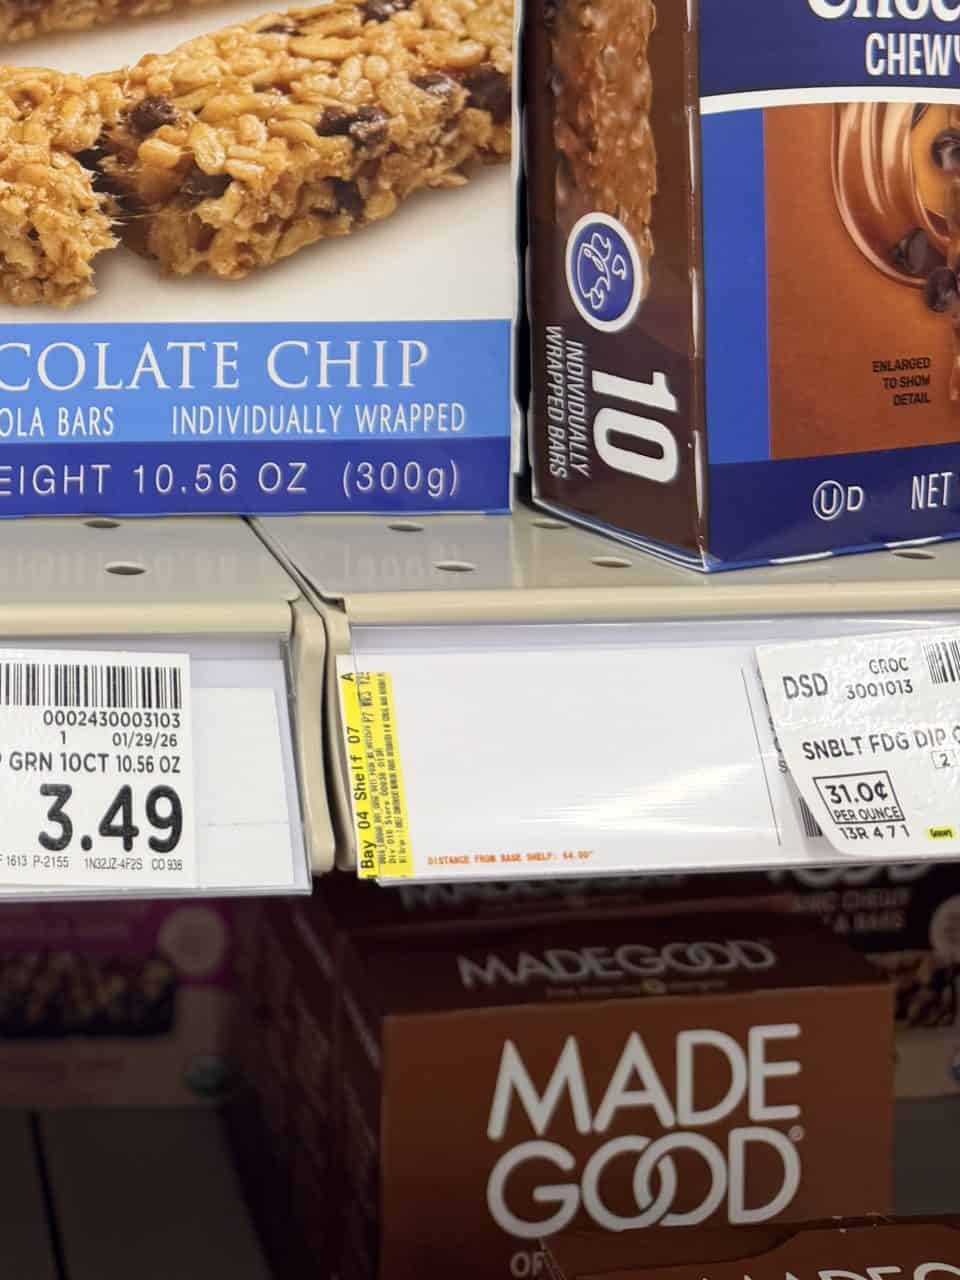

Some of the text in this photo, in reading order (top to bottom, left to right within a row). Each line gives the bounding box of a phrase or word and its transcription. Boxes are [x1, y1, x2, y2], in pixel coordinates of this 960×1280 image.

[265, 338, 431, 389] CHIP
[872, 357, 931, 373] ENLARGED
[883, 373, 931, 390] TO SHOW
[545, 325, 568, 480] WRAPPED BARS
[565, 339, 591, 479] INDIVIDUALLY
[893, 391, 931, 407] DETAIL
[56, 406, 116, 437] BARS
[171, 402, 343, 437] INDIVIDUALLY
[353, 402, 467, 434] WRAPPED
[591, 369, 680, 484] 10
[133, 462, 239, 495] 10.56
[257, 462, 307, 494] OZ
[341, 458, 461, 498] (300g)
[911, 471, 953, 510] NET
[782, 657, 909, 699] DSD GROC
[846, 679, 913, 700] 3001013
[42, 709, 182, 729] 0002430003103
[346, 726, 361, 744] 07
[59, 730, 179, 748] 1 01/29/26
[802, 727, 946, 760] SNBLT FDG DIP
[8, 751, 54, 772] GRN
[59, 752, 110, 773] 10CT
[115, 754, 155, 774] 10.56
[159, 754, 182, 774] OZ
[939, 753, 951, 767] 2
[350, 755, 368, 801] Shelf
[37, 783, 183, 854] 3.49
[357, 811, 371, 829] 04
[833, 806, 900, 821] PER OUNCE
[840, 826, 869, 840] 13R
[873, 826, 882, 838] 4
[887, 825, 896, 838] 7
[360, 839, 377, 869] Bay
[457, 939, 777, 989] MADEGOOD
[486, 1023, 804, 1142] MADE
[486, 1126, 805, 1239] GOOD
